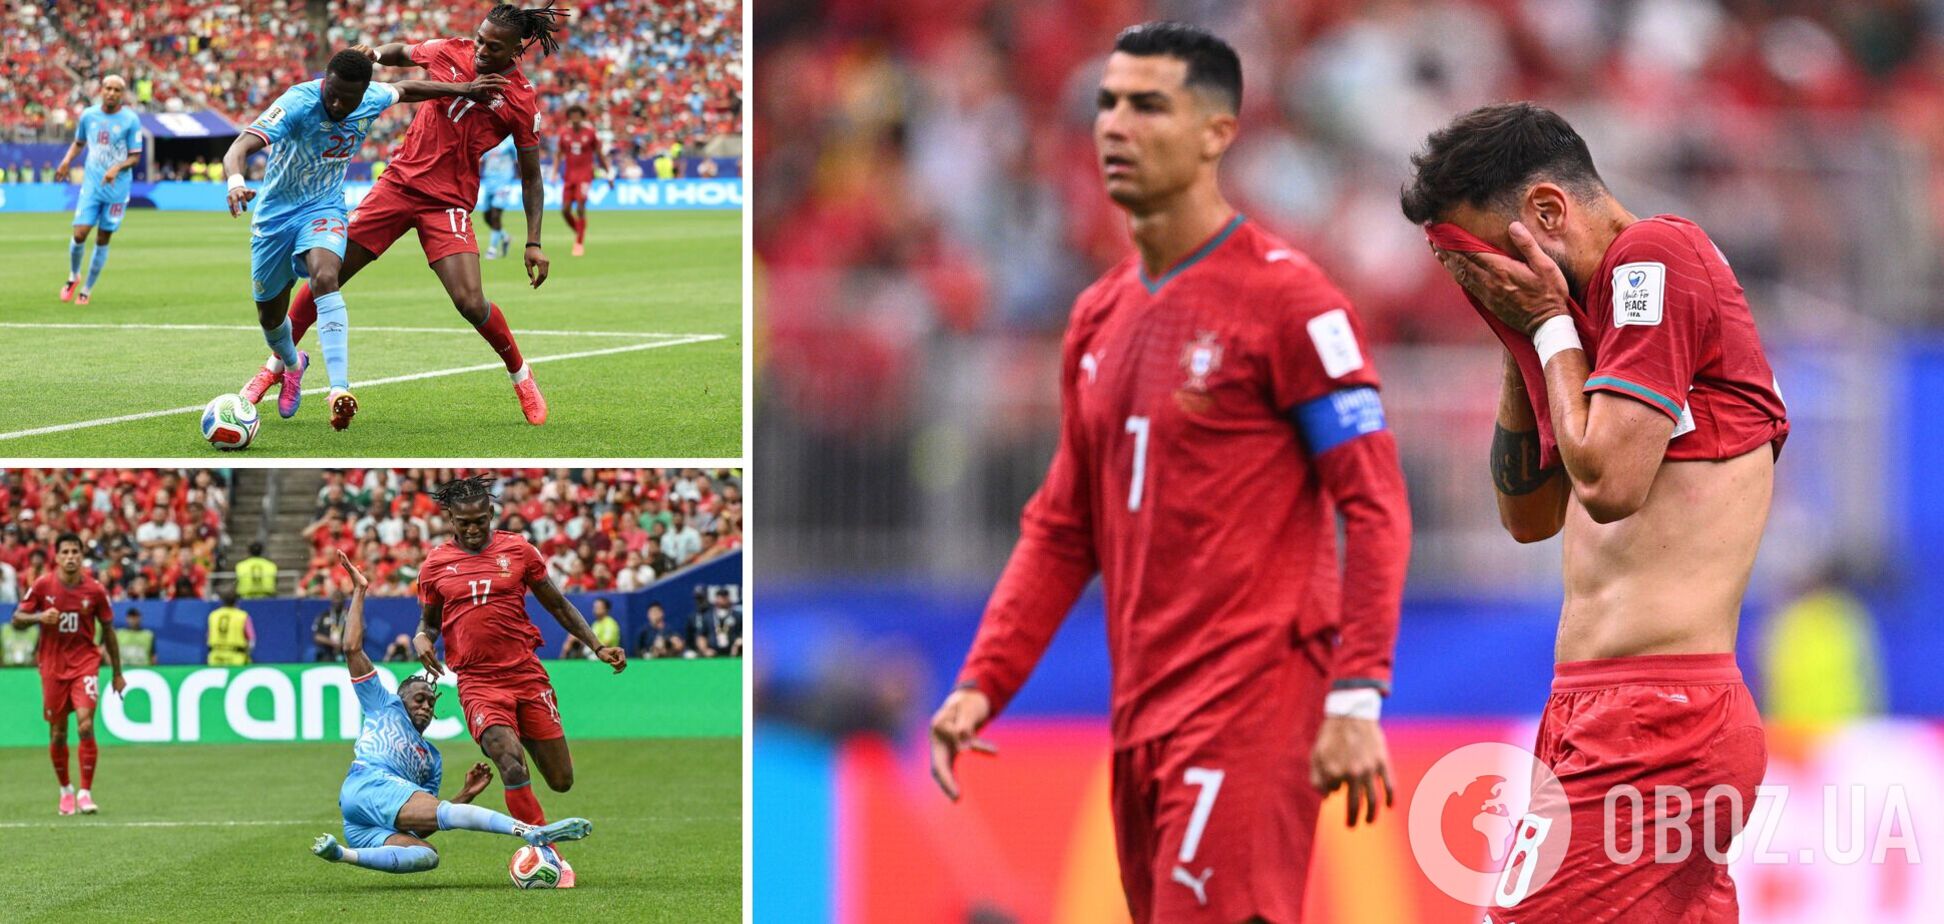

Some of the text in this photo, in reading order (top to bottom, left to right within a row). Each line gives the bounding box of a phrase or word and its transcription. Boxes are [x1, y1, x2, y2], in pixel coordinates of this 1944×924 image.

[447, 95, 477, 123] 17
[322, 134, 355, 158] 22
[617, 182, 659, 206] IN
[312, 218, 346, 238] 22
[445, 207, 468, 234] 17
[1625, 301, 1647, 311] PEACE
[1125, 415, 1150, 513] 7
[468, 579, 493, 606] 17
[59, 611, 79, 633] 20
[1179, 766, 1226, 863] 7
[1496, 813, 1552, 908] 8
